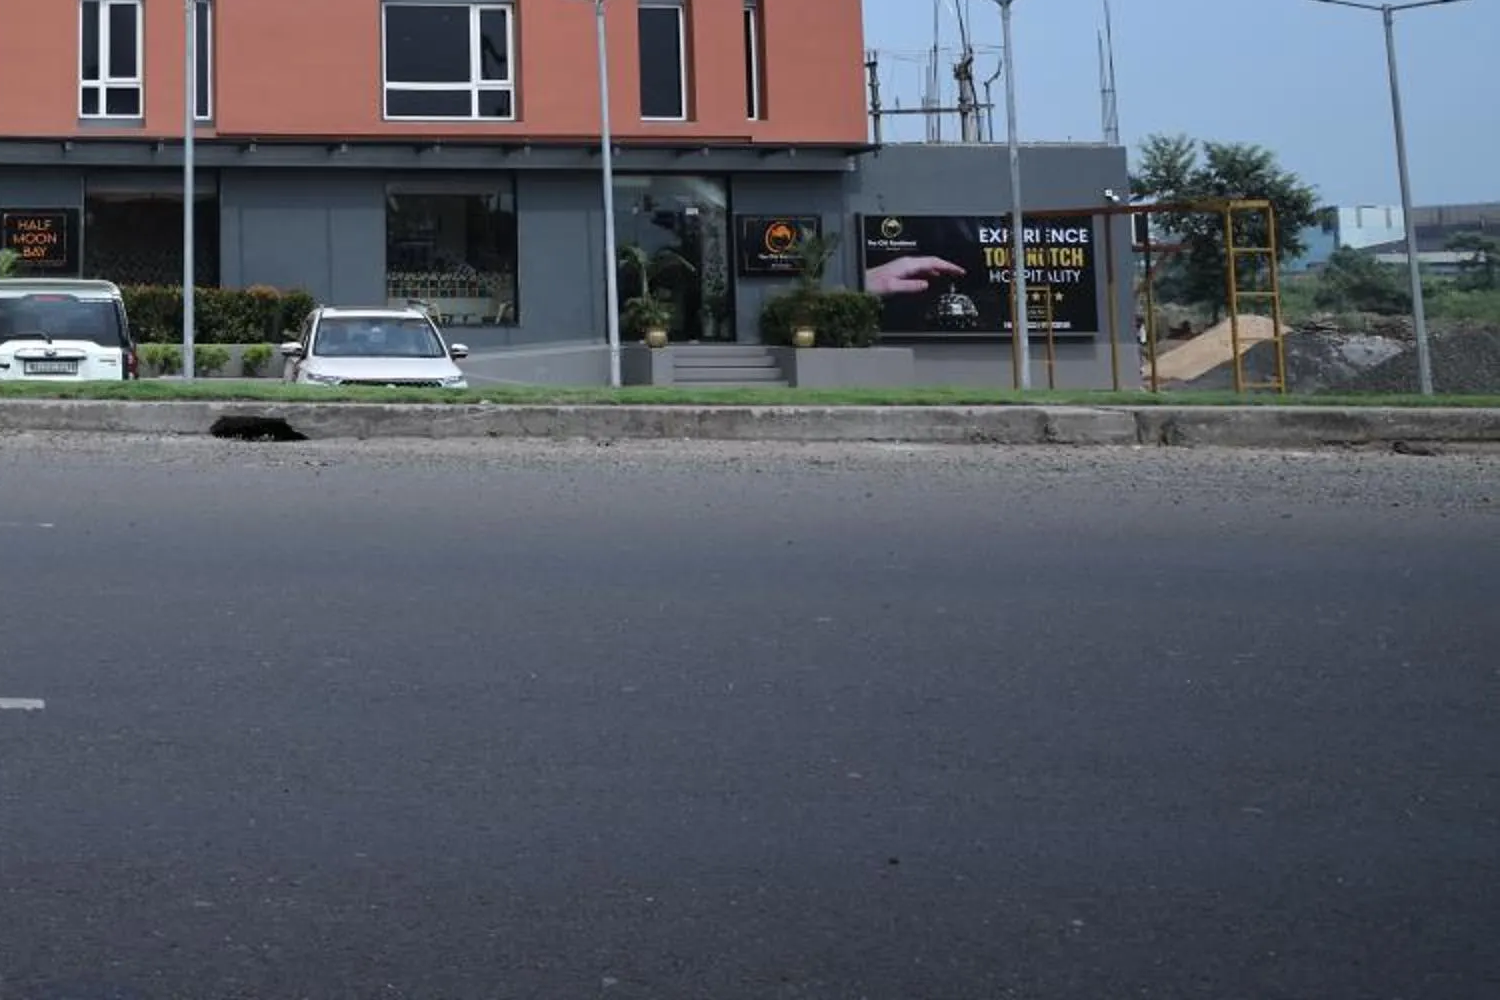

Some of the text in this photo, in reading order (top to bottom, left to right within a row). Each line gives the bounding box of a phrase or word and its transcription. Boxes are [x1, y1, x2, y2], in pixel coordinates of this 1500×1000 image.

[18, 219, 53, 231] HALF
[12, 232, 58, 245] MOON
[979, 228, 1090, 243] EXRINCE
[23, 247, 48, 258] BAY
[983, 247, 1014, 267] TO
[989, 269, 1081, 283] HOPITLITY
